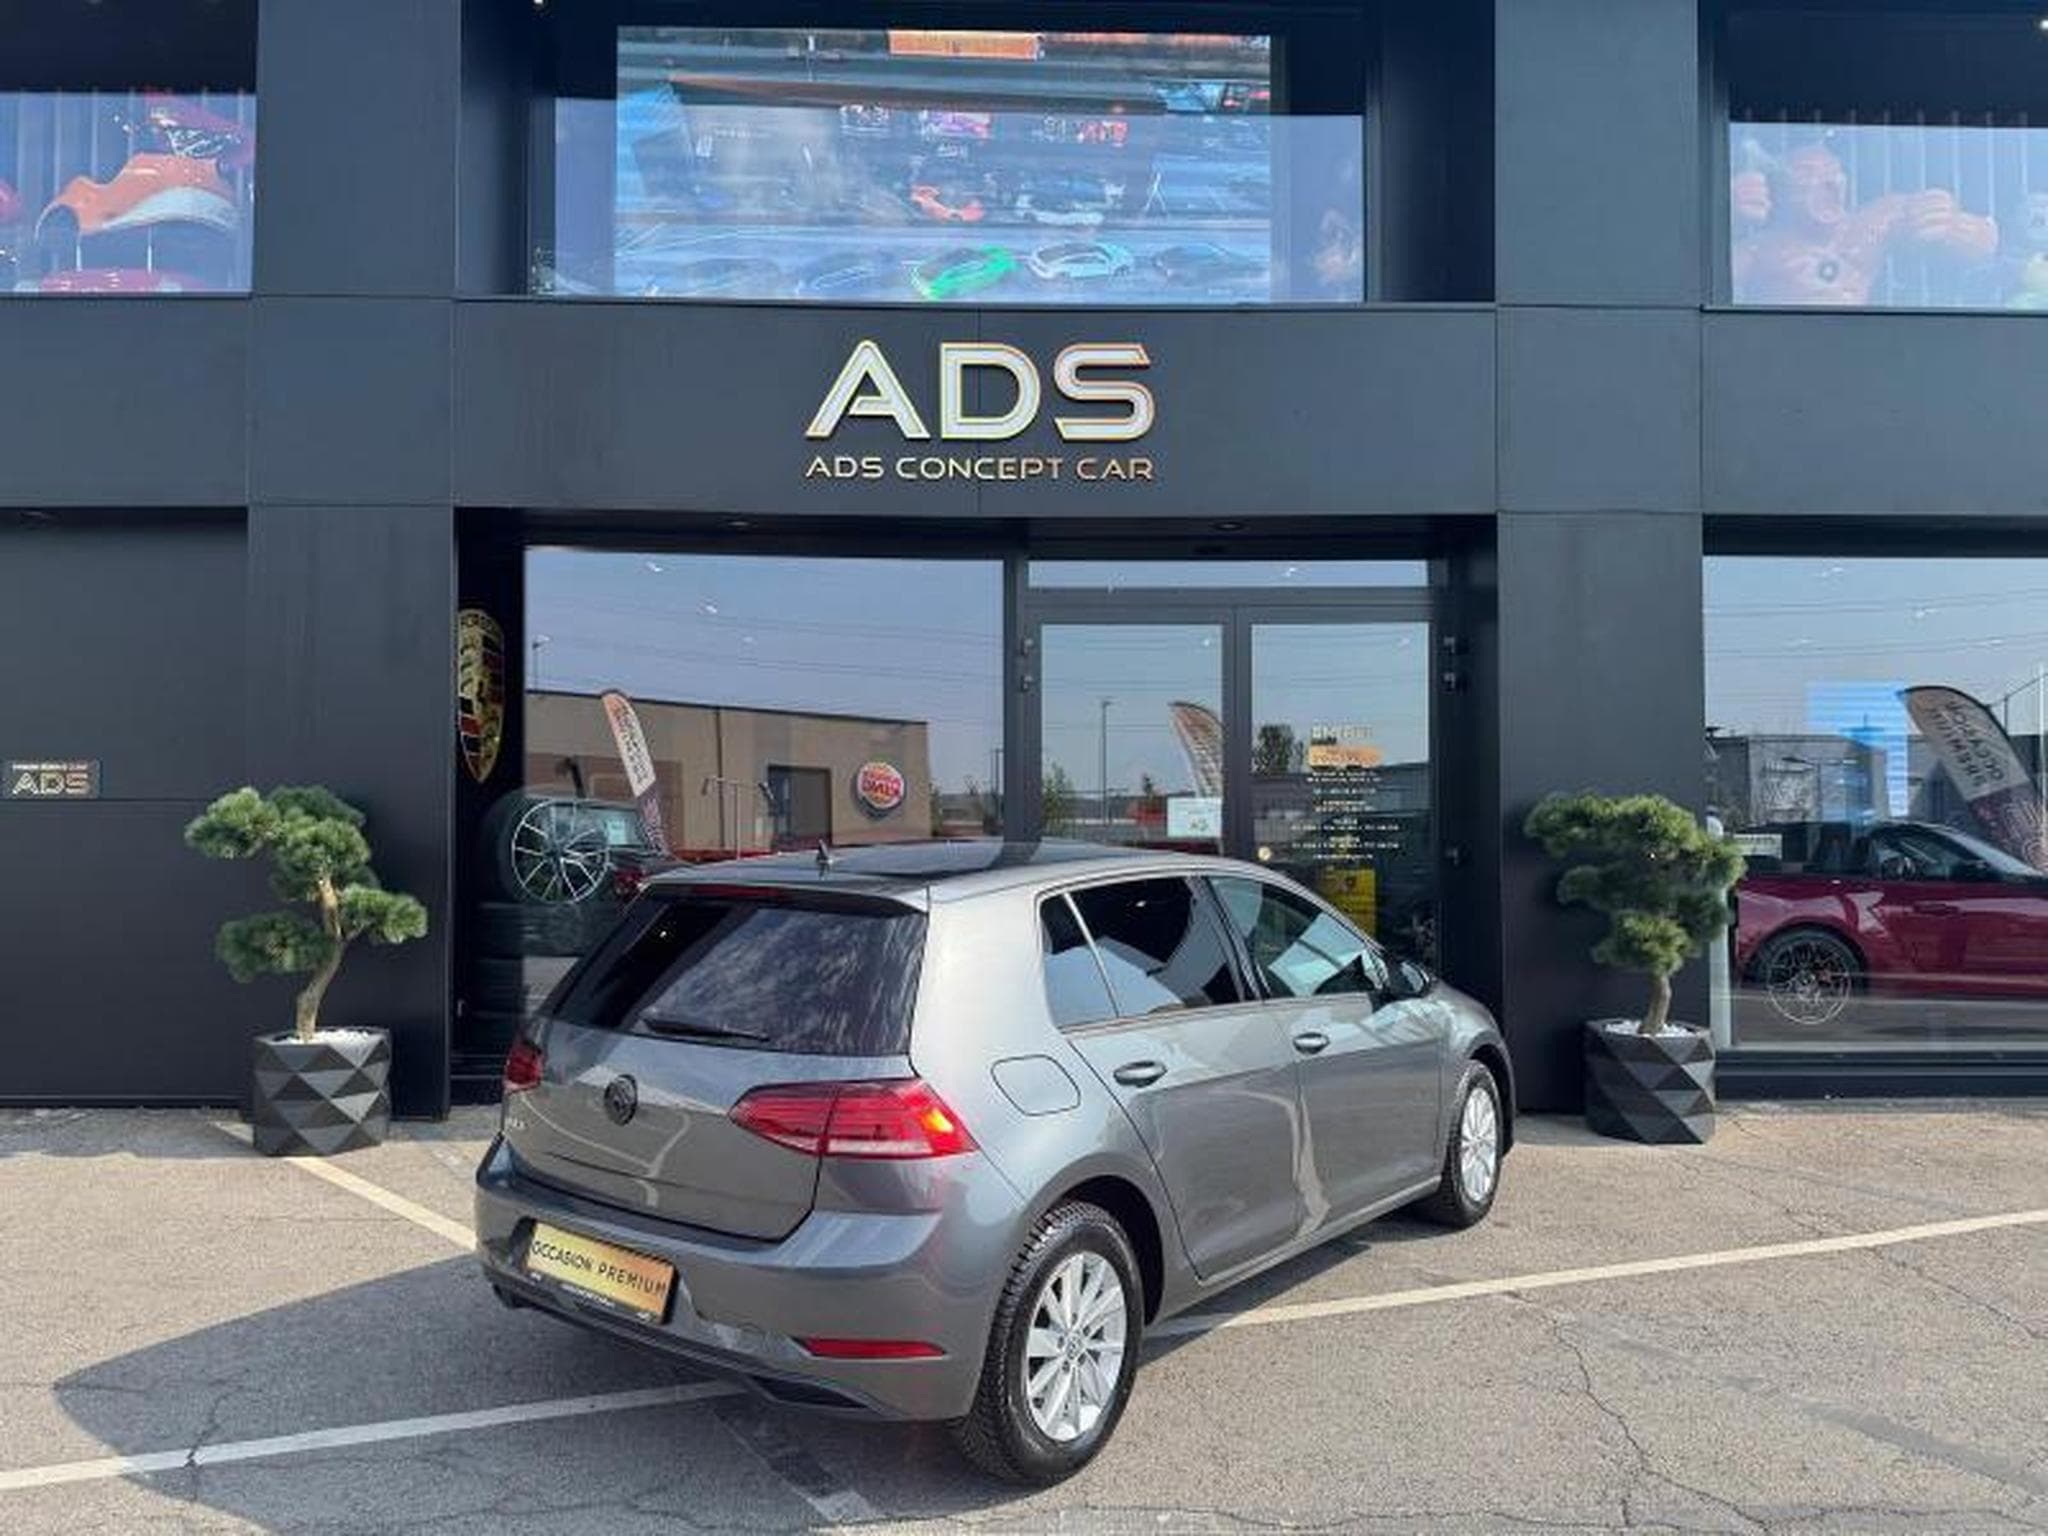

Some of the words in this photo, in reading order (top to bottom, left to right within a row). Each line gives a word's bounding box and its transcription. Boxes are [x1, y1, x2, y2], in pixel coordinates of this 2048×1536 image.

[805, 340, 1155, 440] ADS
[805, 456, 884, 478] ADS
[896, 457, 1063, 480] CONCEPT
[1076, 458, 1154, 480] CAR
[11, 772, 90, 795] ADS
[531, 1240, 593, 1272] OCCASION
[598, 1261, 667, 1297] PREMIUM
